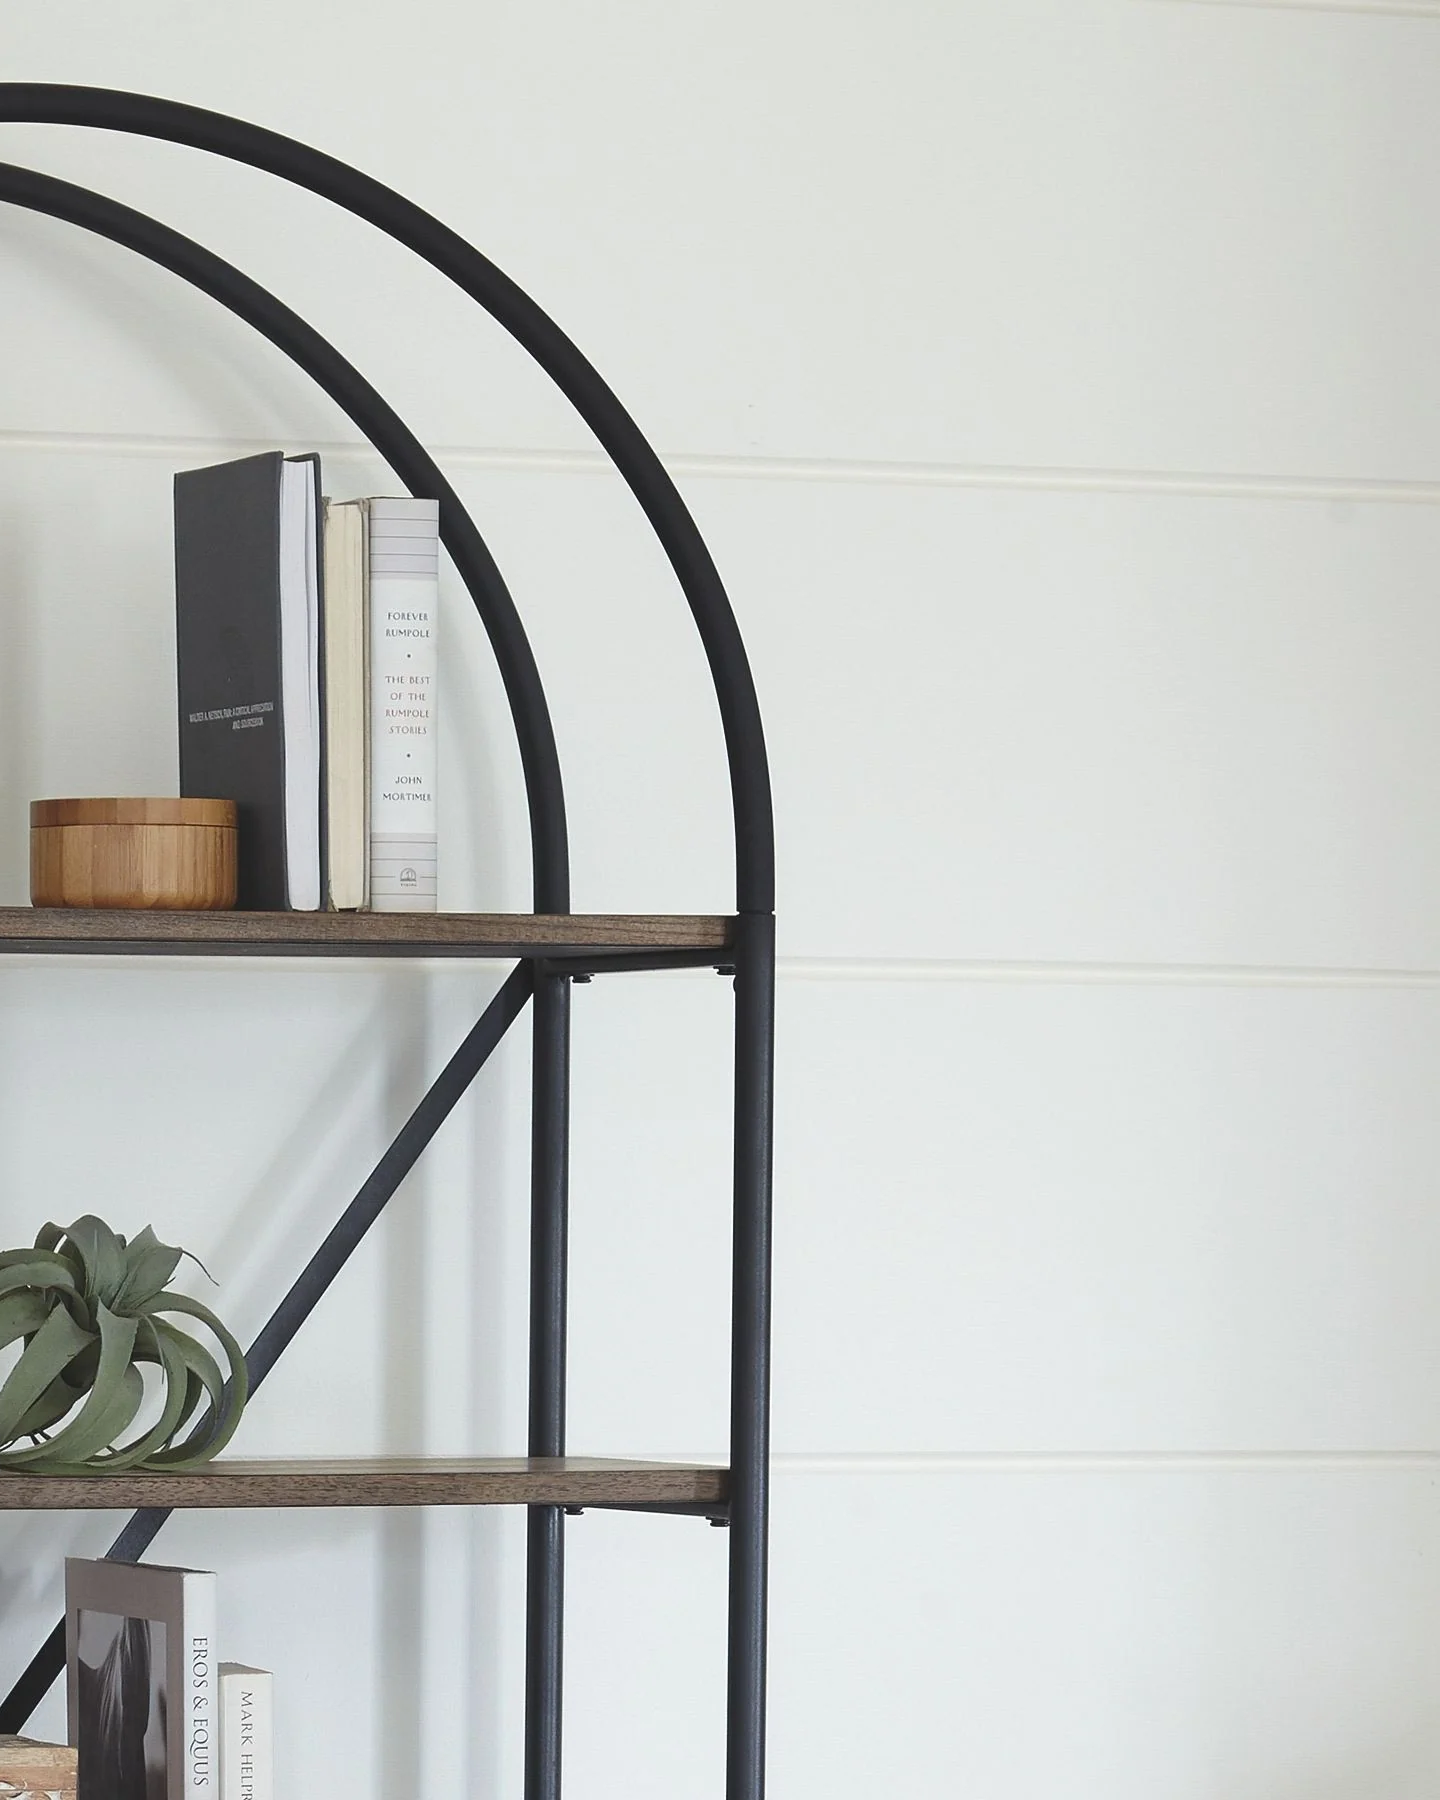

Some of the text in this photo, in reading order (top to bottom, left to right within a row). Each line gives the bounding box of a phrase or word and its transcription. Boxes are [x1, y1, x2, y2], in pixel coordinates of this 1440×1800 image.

[387, 612, 428, 621] FOREVER
[385, 629, 429, 638] RUMPOLE
[385, 675, 431, 684] THE BEST
[390, 692, 426, 701] OF THE
[385, 709, 429, 718] RUMPOLE
[389, 725, 427, 735] STORIES
[394, 776, 422, 784] JOHN
[382, 792, 432, 801] MORTIMER
[190, 1638, 209, 1786] EROS & EQUUS
[241, 1691, 253, 1746] MARK
